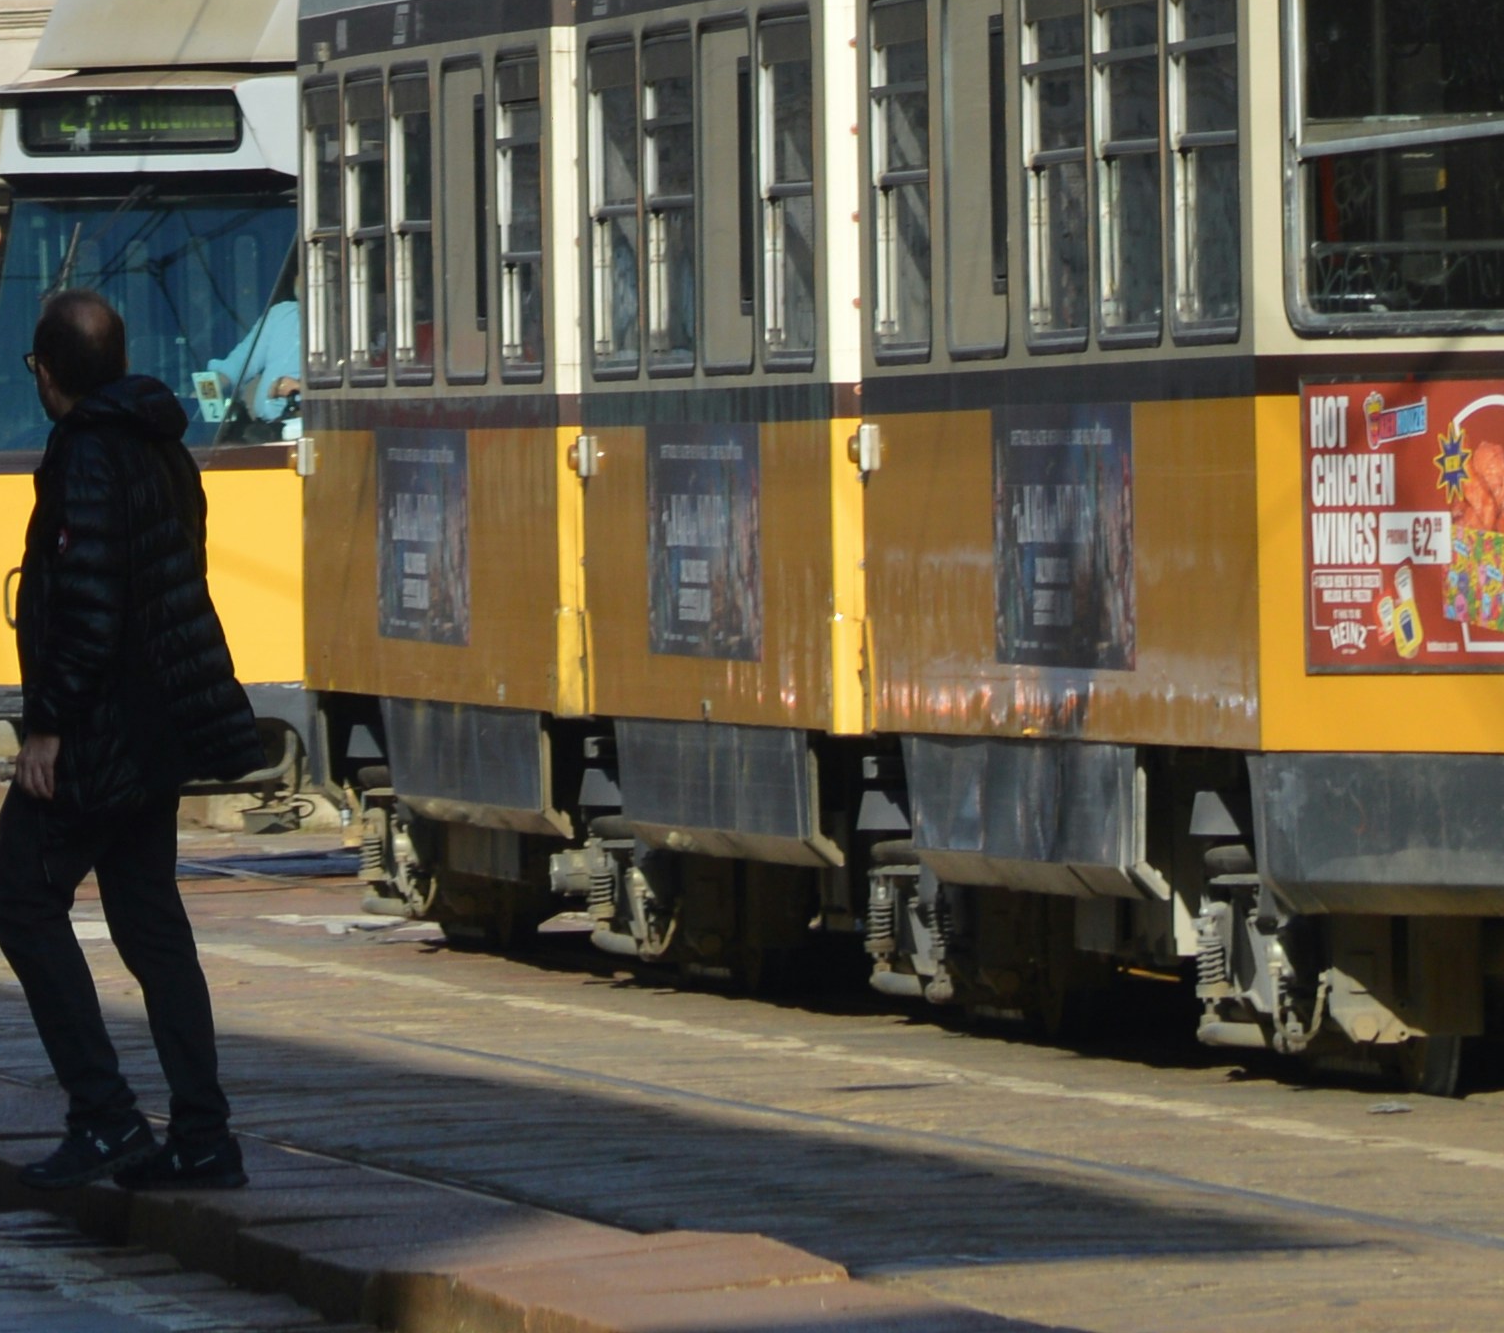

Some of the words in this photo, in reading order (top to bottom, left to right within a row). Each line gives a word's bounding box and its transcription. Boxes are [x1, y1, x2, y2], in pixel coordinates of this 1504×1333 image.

[1310, 396, 1349, 448] HOT
[1311, 454, 1395, 507] CHICKEN
[1312, 512, 1377, 565] WINGS
[1329, 621, 1368, 650] HEINZ
